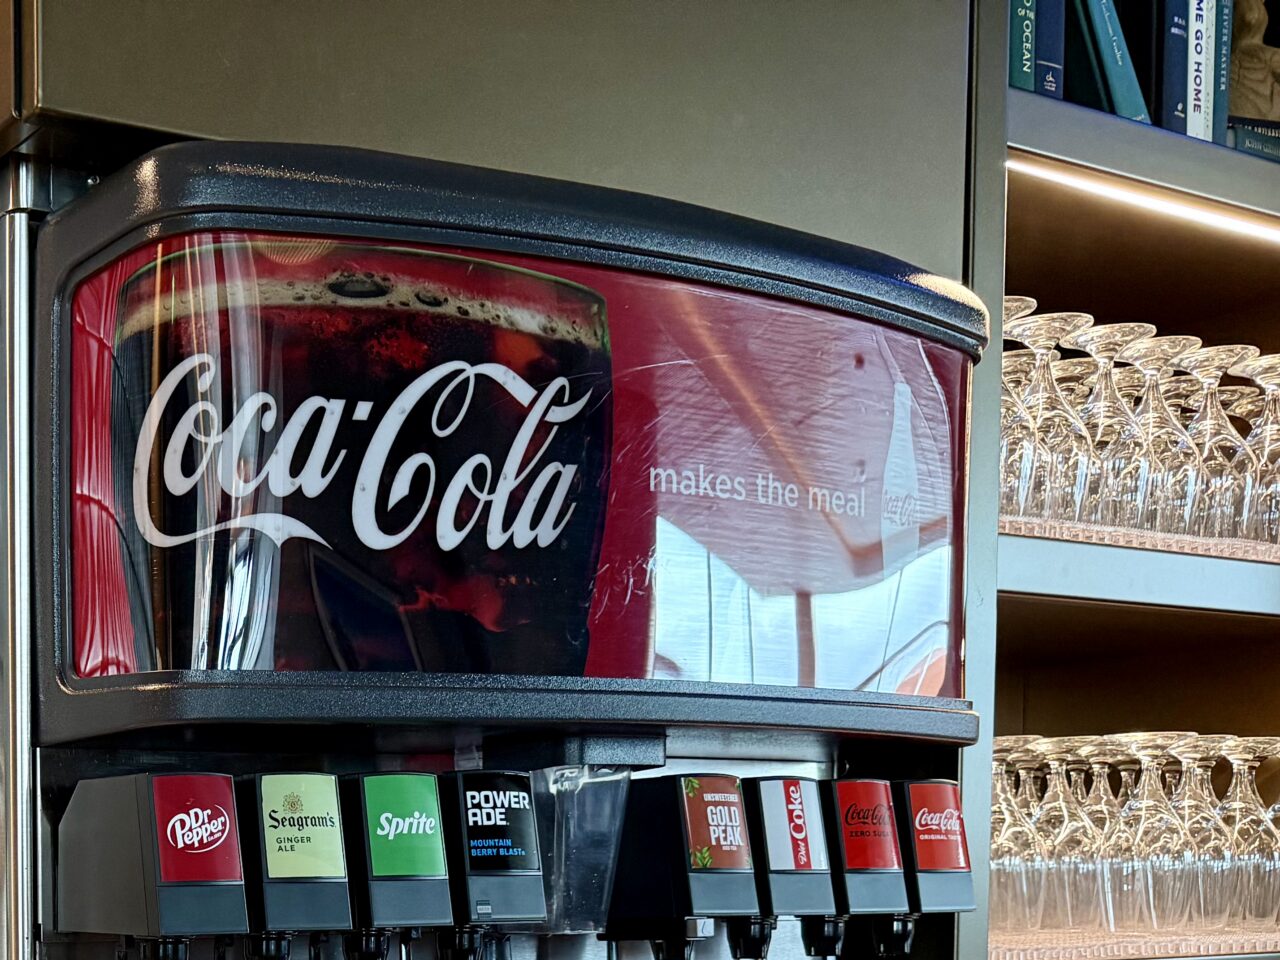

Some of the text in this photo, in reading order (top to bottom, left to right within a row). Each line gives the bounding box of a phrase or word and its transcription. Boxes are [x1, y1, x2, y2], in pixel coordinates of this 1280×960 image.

[1022, 20, 1032, 73] OCEAN
[1194, 29, 1203, 55] GO
[1193, 61, 1203, 114] HOME
[132, 353, 593, 551] Coca-Cola
[649, 464, 865, 517] makes the meal
[466, 790, 530, 809] POWER
[268, 809, 335, 831] Seagram's
[376, 811, 436, 840] Sprite
[468, 808, 507, 826] ADE
[707, 805, 740, 826] GOLD
[788, 785, 807, 865] Diet Coke
[915, 807, 960, 830] Coca-Cola
[167, 808, 225, 849] Dr Pepper
[276, 836, 312, 844] GINGER
[709, 826, 745, 846] PEAK
[470, 839, 512, 847] MOUNTAIN
